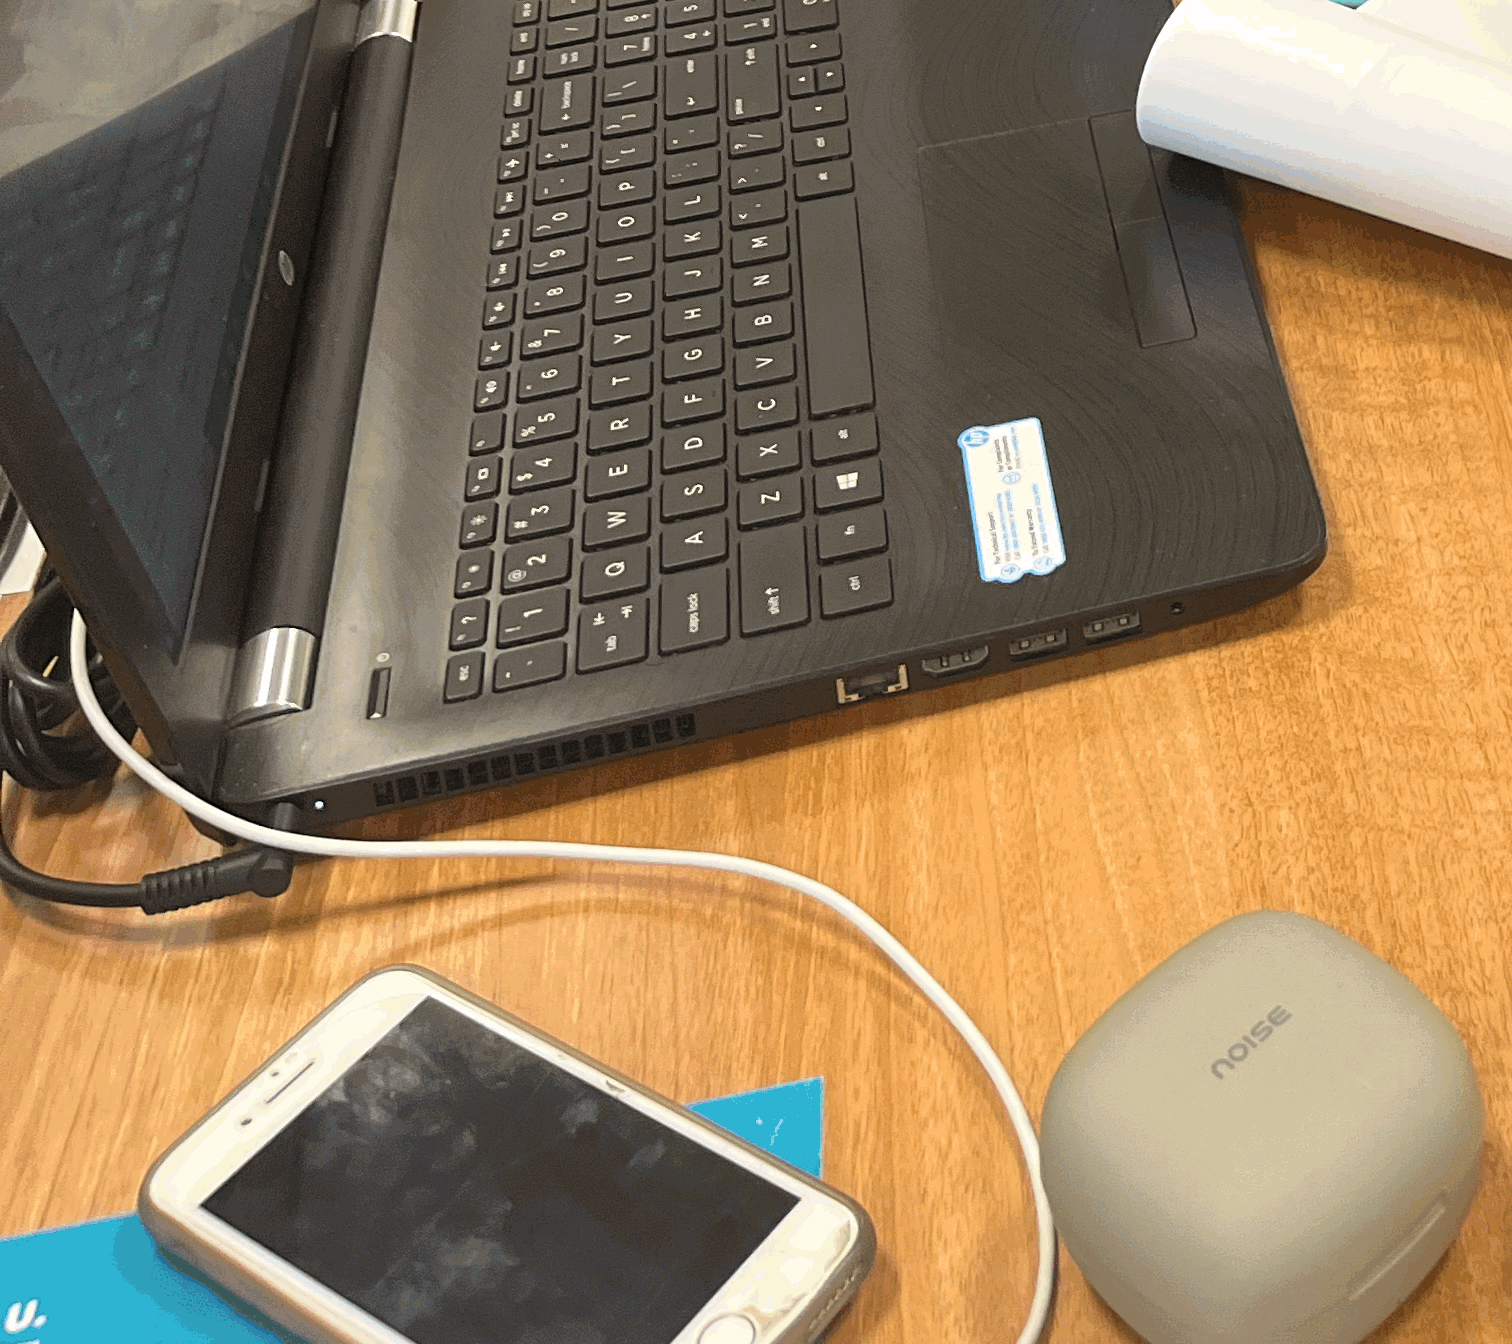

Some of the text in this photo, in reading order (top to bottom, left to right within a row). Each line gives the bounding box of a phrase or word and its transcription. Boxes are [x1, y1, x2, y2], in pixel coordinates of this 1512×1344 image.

[683, 4, 699, 12] 5
[618, 181, 636, 191] P
[684, 195, 701, 206] L
[683, 231, 701, 243] K
[751, 235, 769, 249] M
[549, 249, 566, 258] 9
[683, 269, 702, 277] J
[752, 274, 770, 287] N
[546, 286, 564, 297] 8
[614, 292, 633, 304] U
[683, 307, 702, 320] H
[754, 314, 773, 326] B
[543, 329, 561, 337] 7
[613, 334, 632, 345] Y
[683, 348, 703, 361] G
[755, 357, 774, 369] V
[540, 368, 559, 379] 6
[611, 376, 631, 386] T
[683, 394, 703, 404] F
[757, 398, 776, 411] C
[537, 412, 556, 423] 5
[609, 417, 629, 431] R
[683, 437, 703, 451] D
[759, 443, 779, 457] X
[534, 457, 553, 468] 4
[608, 464, 628, 477] E
[683, 483, 704, 496] S
[760, 490, 781, 505] Z
[530, 505, 550, 516] 3
[607, 511, 627, 529] W
[684, 530, 704, 544] A
[526, 553, 547, 566] 2
[604, 561, 625, 577] Q
[523, 608, 543, 618] 1
